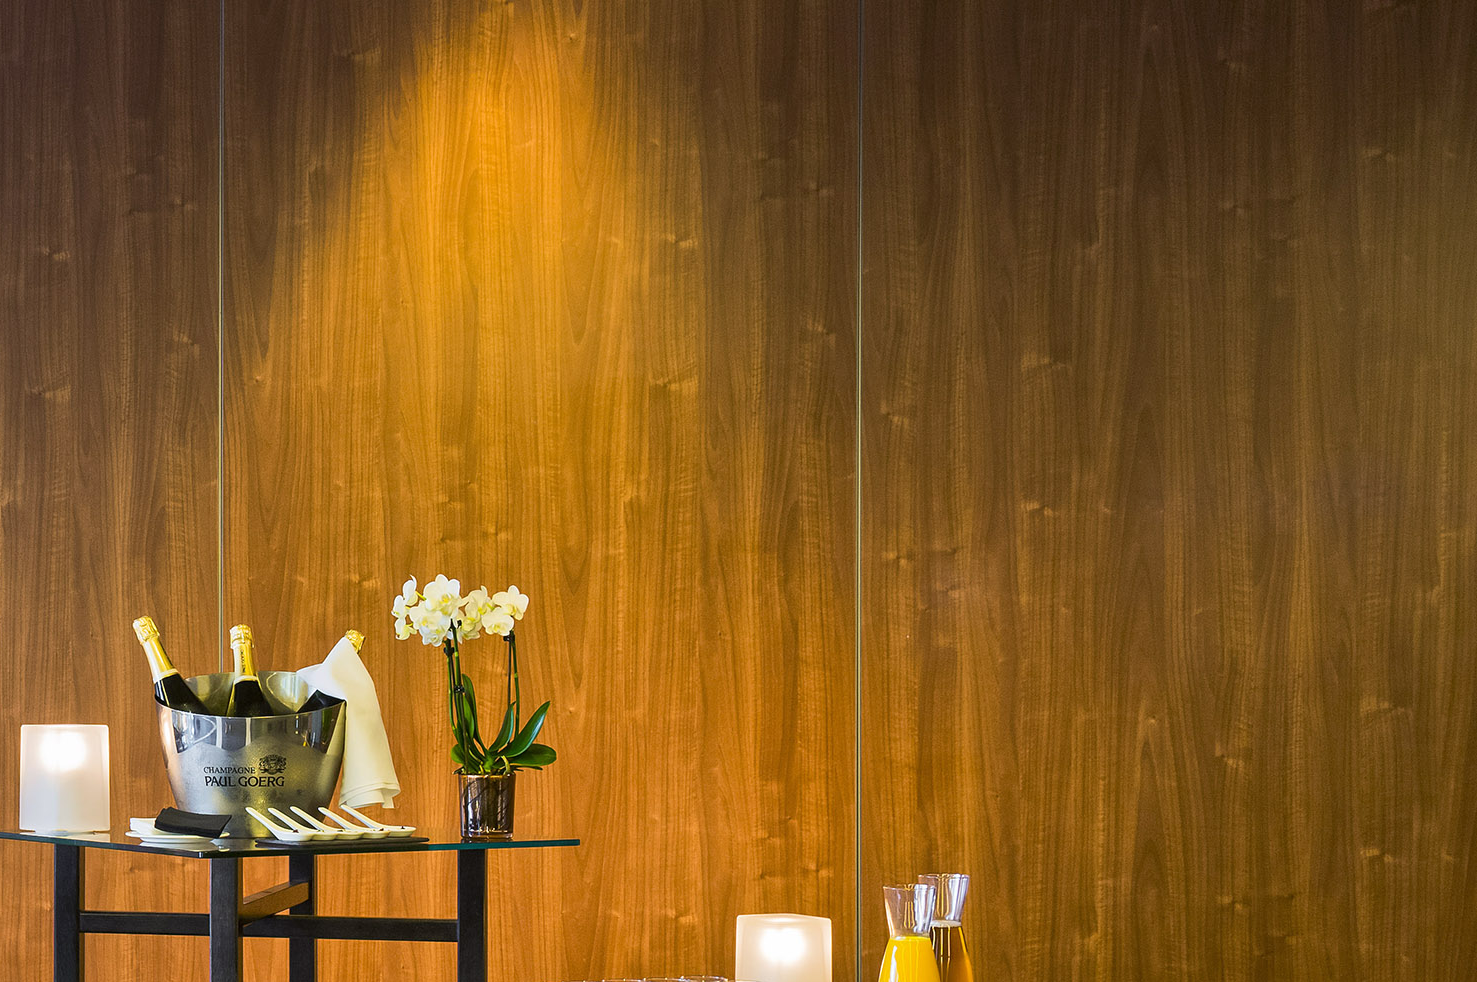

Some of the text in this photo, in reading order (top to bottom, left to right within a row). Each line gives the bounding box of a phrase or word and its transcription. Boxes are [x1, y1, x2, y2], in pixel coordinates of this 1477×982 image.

[203, 766, 256, 774] CHAMPAGNE
[204, 776, 285, 787] PAUL GOERG
